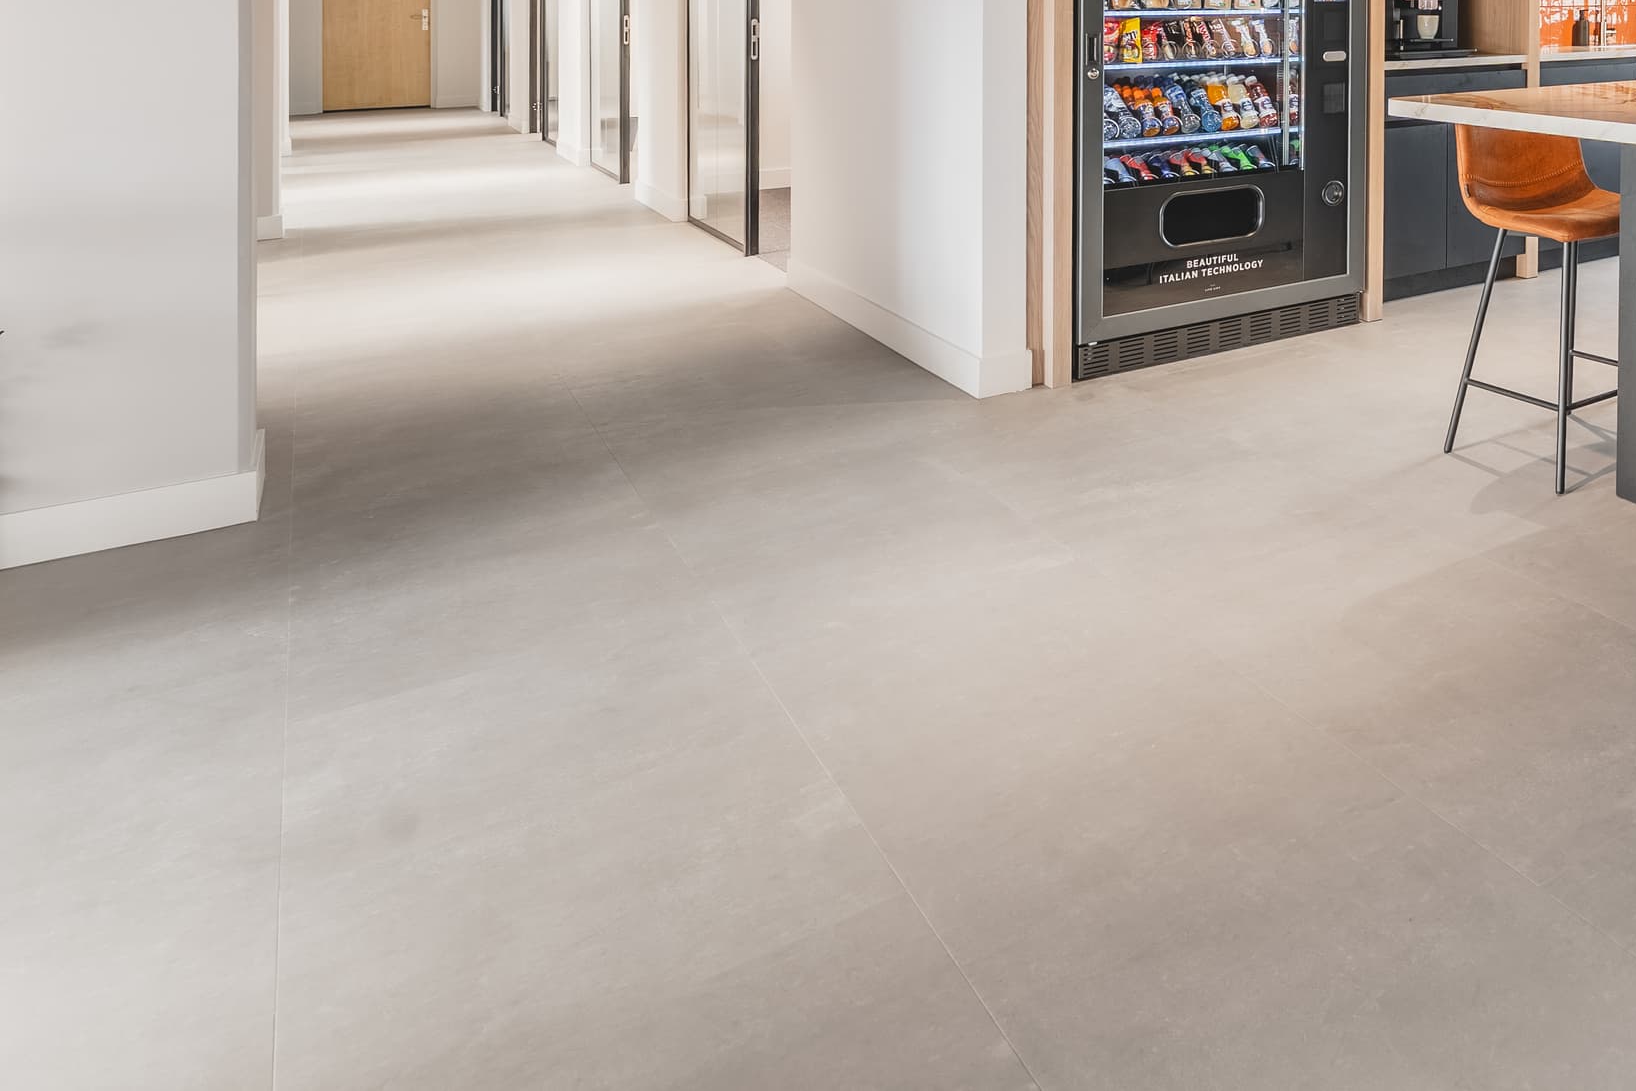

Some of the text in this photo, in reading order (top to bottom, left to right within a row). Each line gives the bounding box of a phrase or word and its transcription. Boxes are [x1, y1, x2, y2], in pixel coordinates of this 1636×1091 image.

[1186, 253, 1239, 269] BEAUTIFUL
[1159, 259, 1264, 284] ITALIAN TECHNOLOGY
